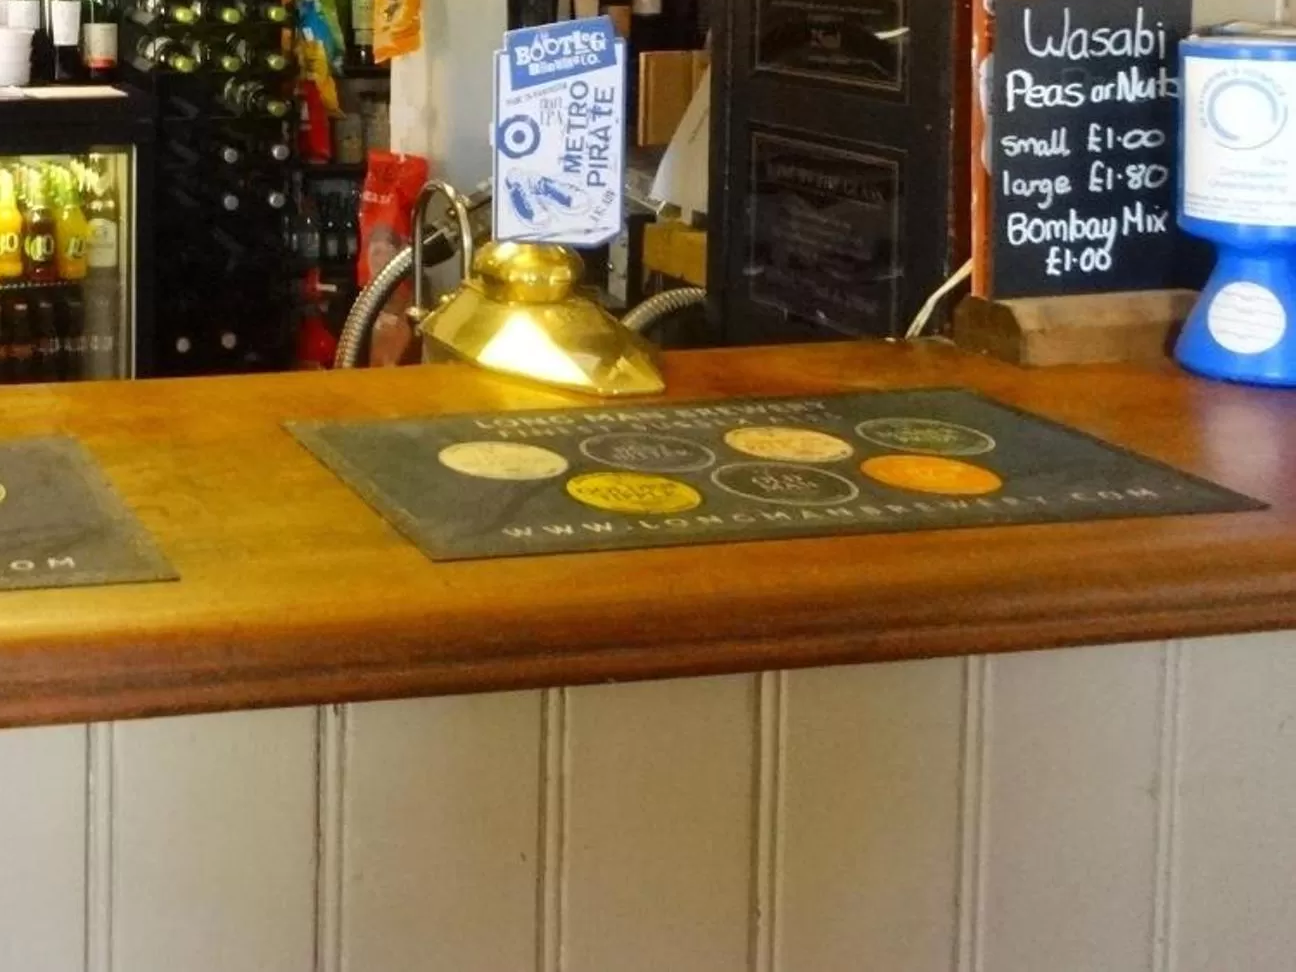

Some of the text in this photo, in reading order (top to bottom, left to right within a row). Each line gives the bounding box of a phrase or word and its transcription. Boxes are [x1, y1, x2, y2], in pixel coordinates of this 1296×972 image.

[1023, 6, 1166, 61] Wasabi
[1006, 68, 1086, 113] Peas
[1090, 82, 1116, 104] or
[562, 80, 589, 174] METRO
[586, 86, 615, 188] PIRATE
[1001, 123, 1165, 158] small £1.00
[1002, 169, 1072, 209] large
[1088, 160, 1169, 192] £1.80
[1006, 208, 1117, 252] Bombay
[1122, 200, 1169, 236] Mix
[1045, 246, 1113, 276] £1.00
[472, 414, 576, 430] LONG
[583, 410, 667, 423] MAN
